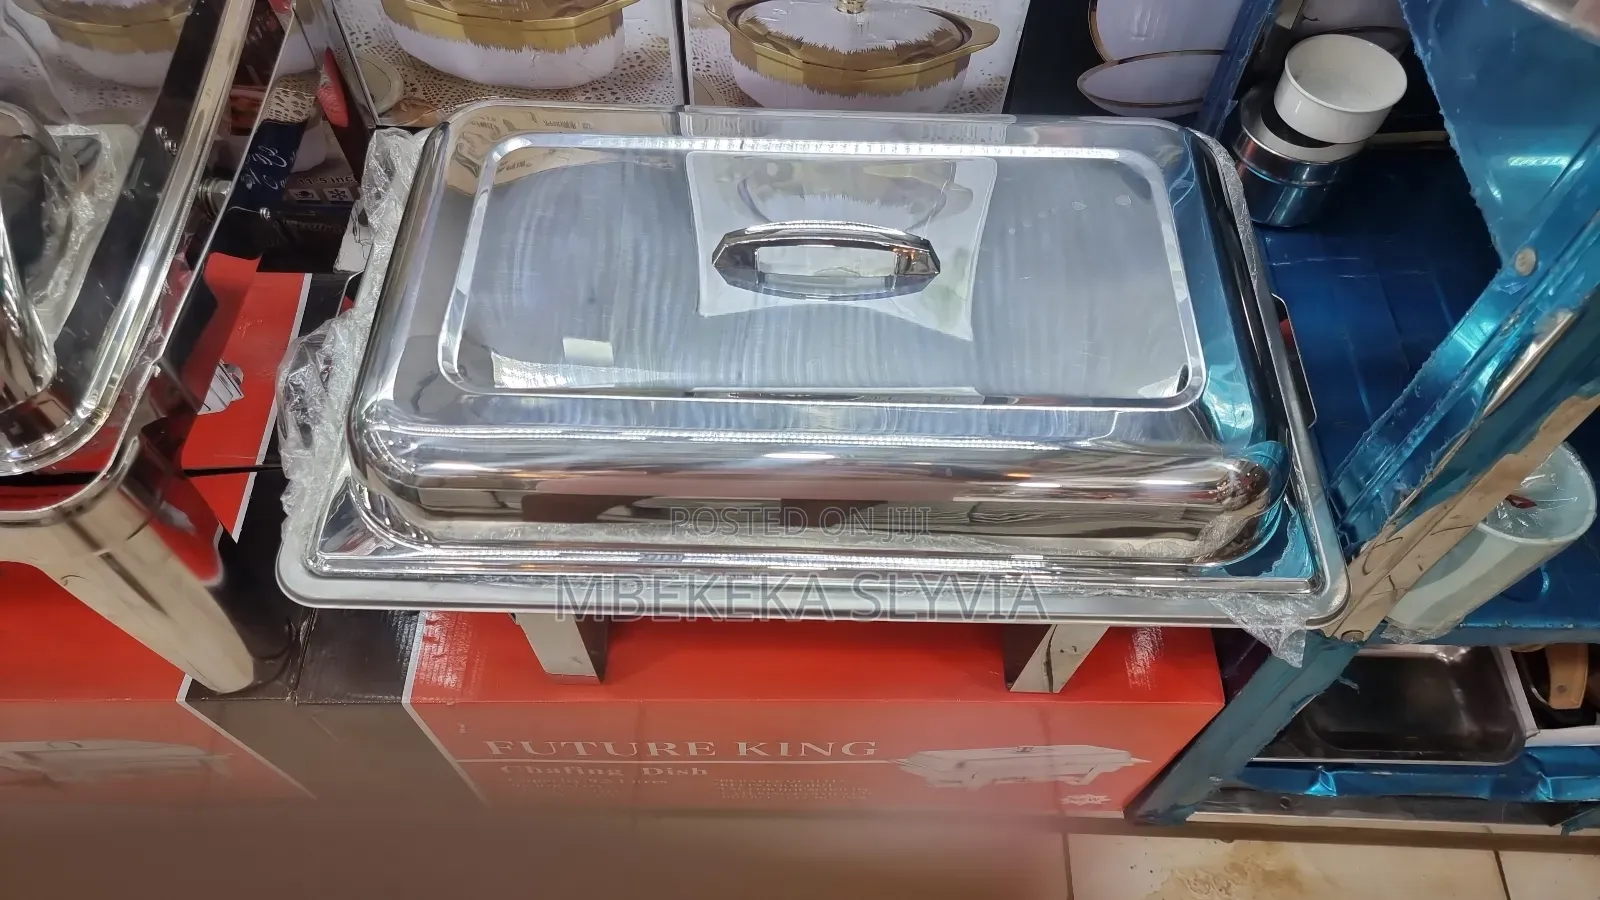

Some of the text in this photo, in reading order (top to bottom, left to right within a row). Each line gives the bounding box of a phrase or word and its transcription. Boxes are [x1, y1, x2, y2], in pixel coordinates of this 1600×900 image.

[330, 174, 358, 184] inc
[482, 740, 879, 757] FUTURE KING
[500, 763, 708, 777] Chafing Dish
